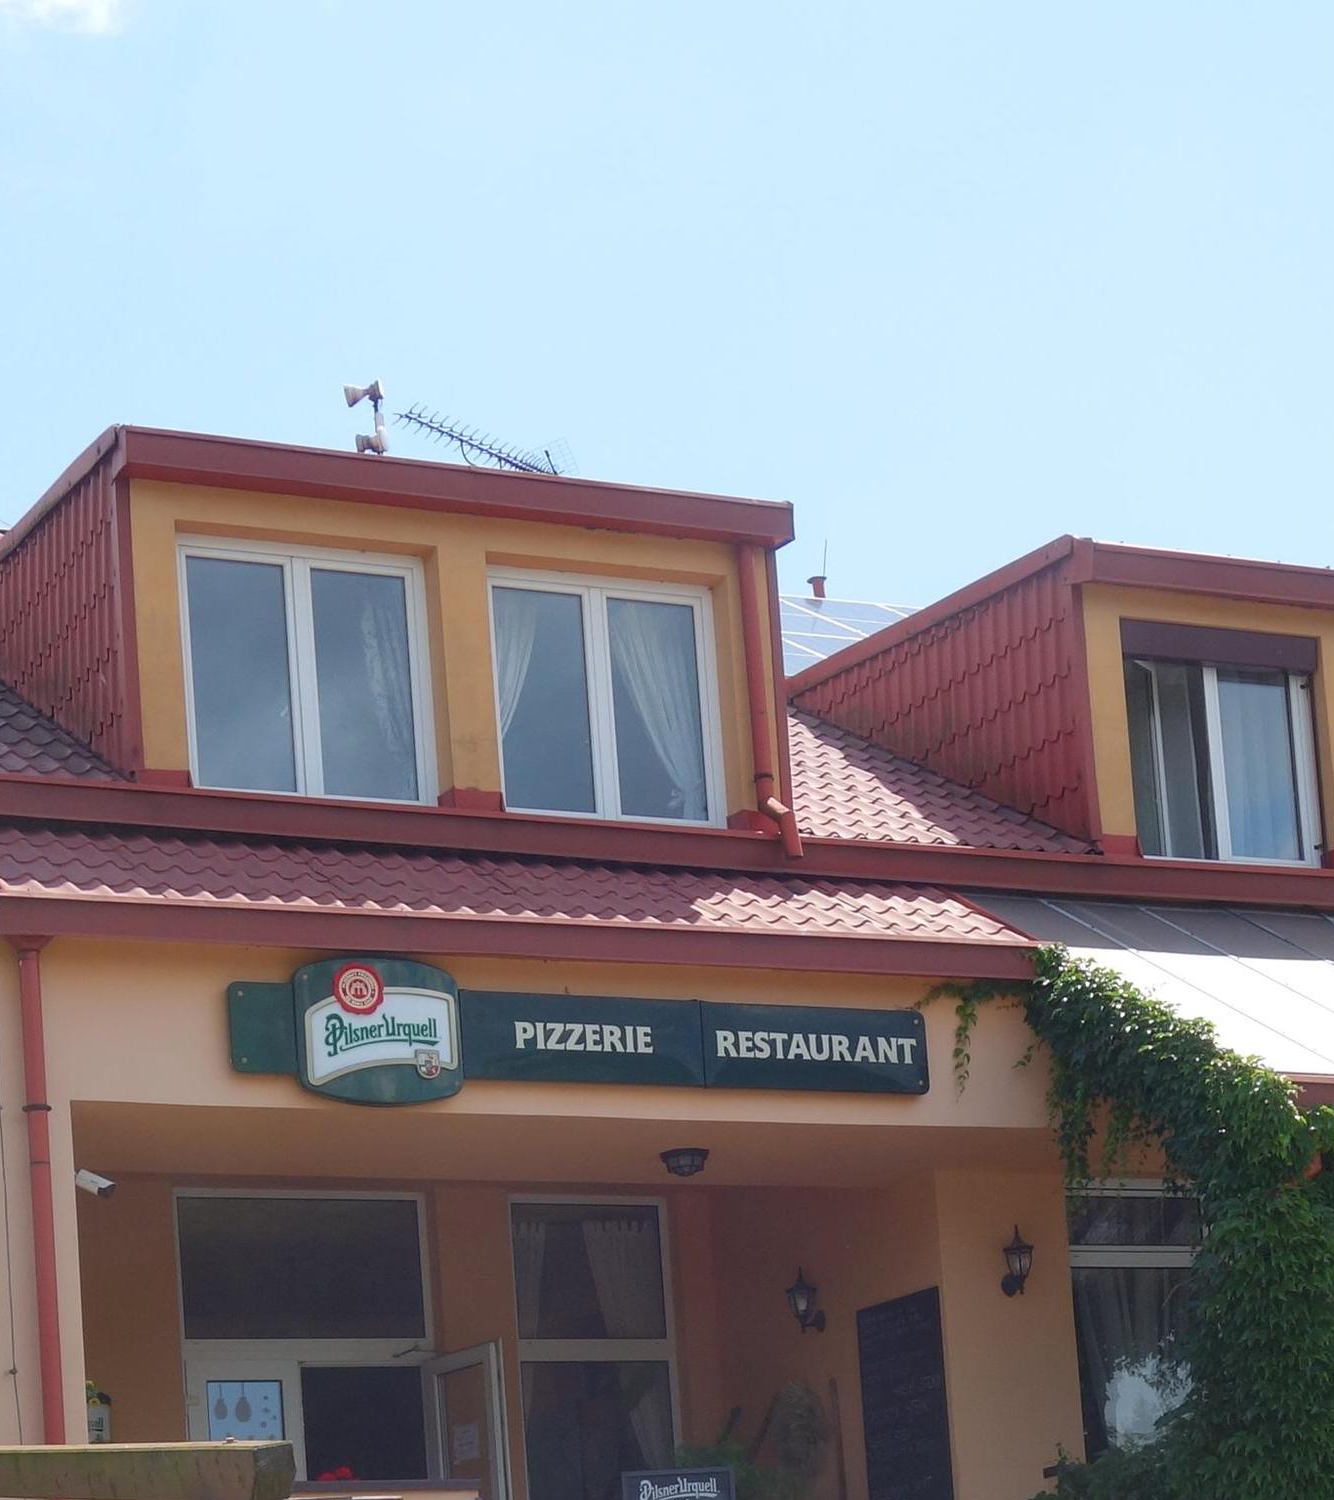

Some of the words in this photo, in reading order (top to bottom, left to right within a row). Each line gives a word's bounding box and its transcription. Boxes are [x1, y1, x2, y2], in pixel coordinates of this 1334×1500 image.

[324, 1013, 384, 1057] Pilsner
[382, 1013, 438, 1047] Urquell
[514, 1021, 654, 1054] PIZZERIE
[715, 1029, 918, 1065] RESTAURANT
[677, 1476, 719, 1500] Urquell
